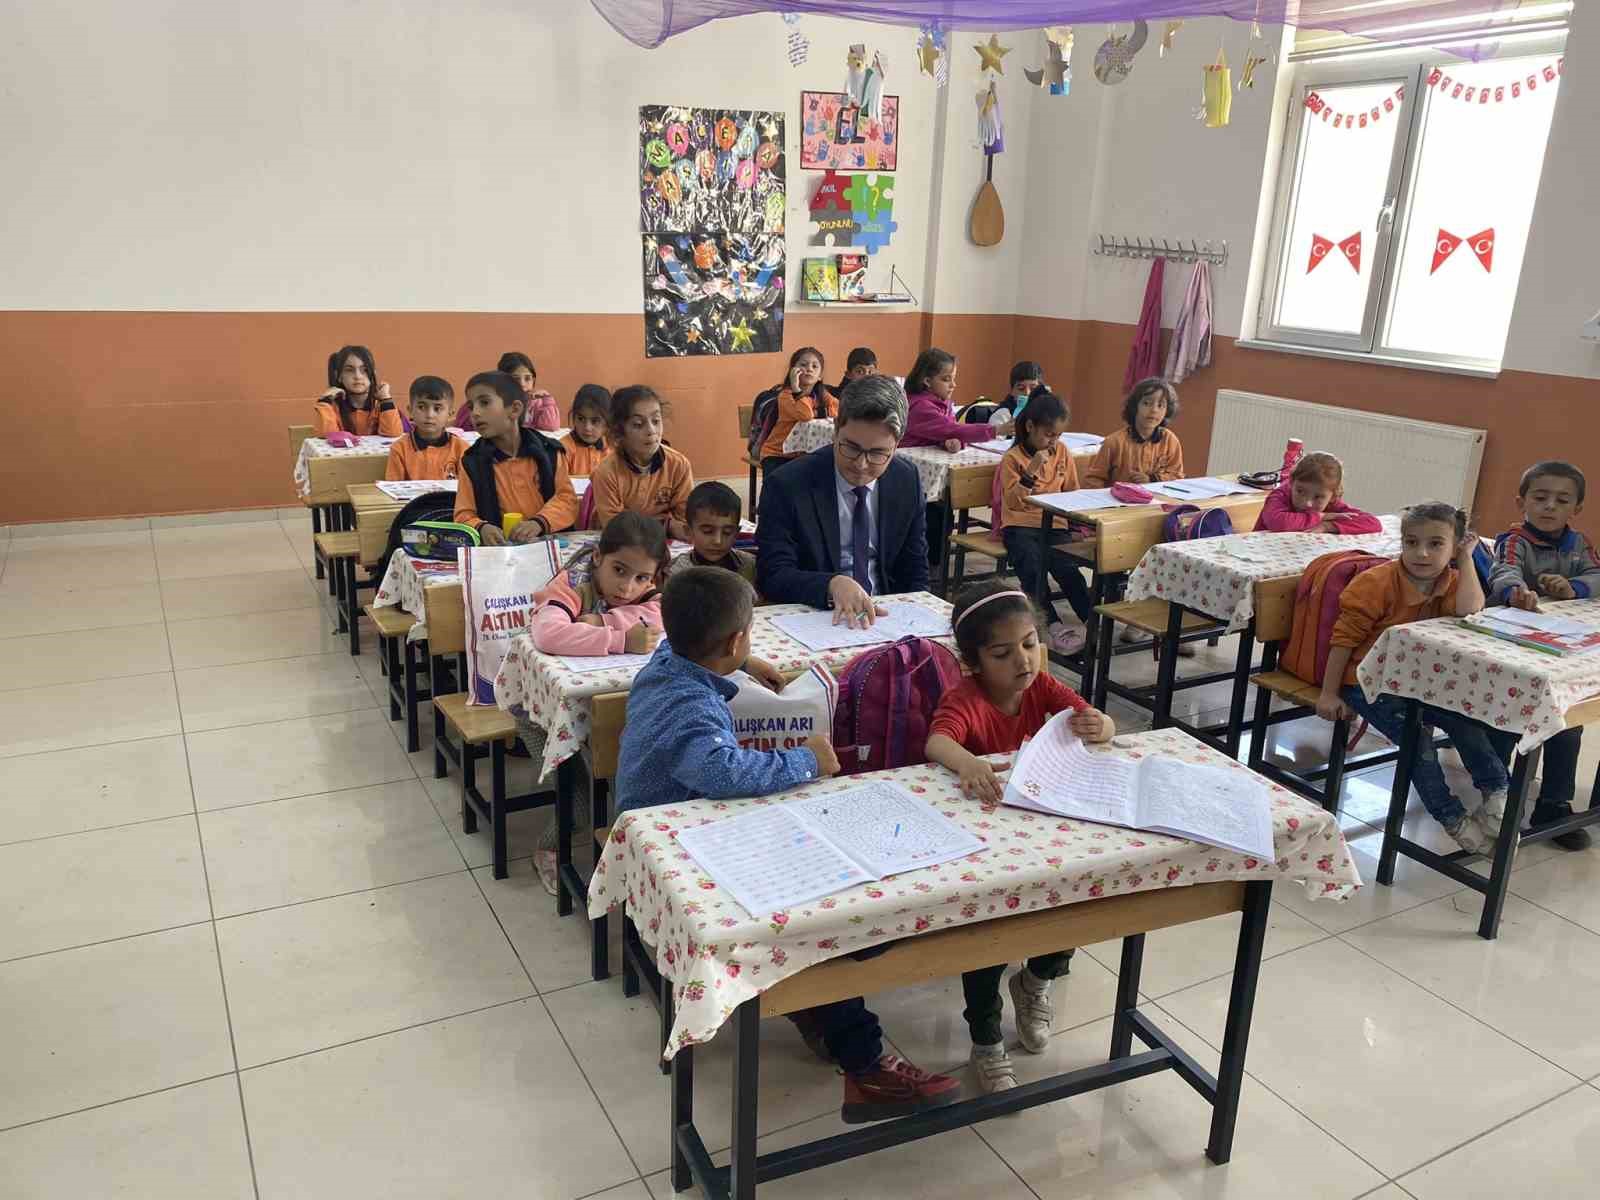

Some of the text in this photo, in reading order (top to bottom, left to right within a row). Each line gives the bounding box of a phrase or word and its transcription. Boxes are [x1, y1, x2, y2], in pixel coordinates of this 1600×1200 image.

[480, 609, 525, 632] ALTIN
[735, 716, 813, 735] LIŞKAN ARI
[738, 736, 777, 752] TIN
